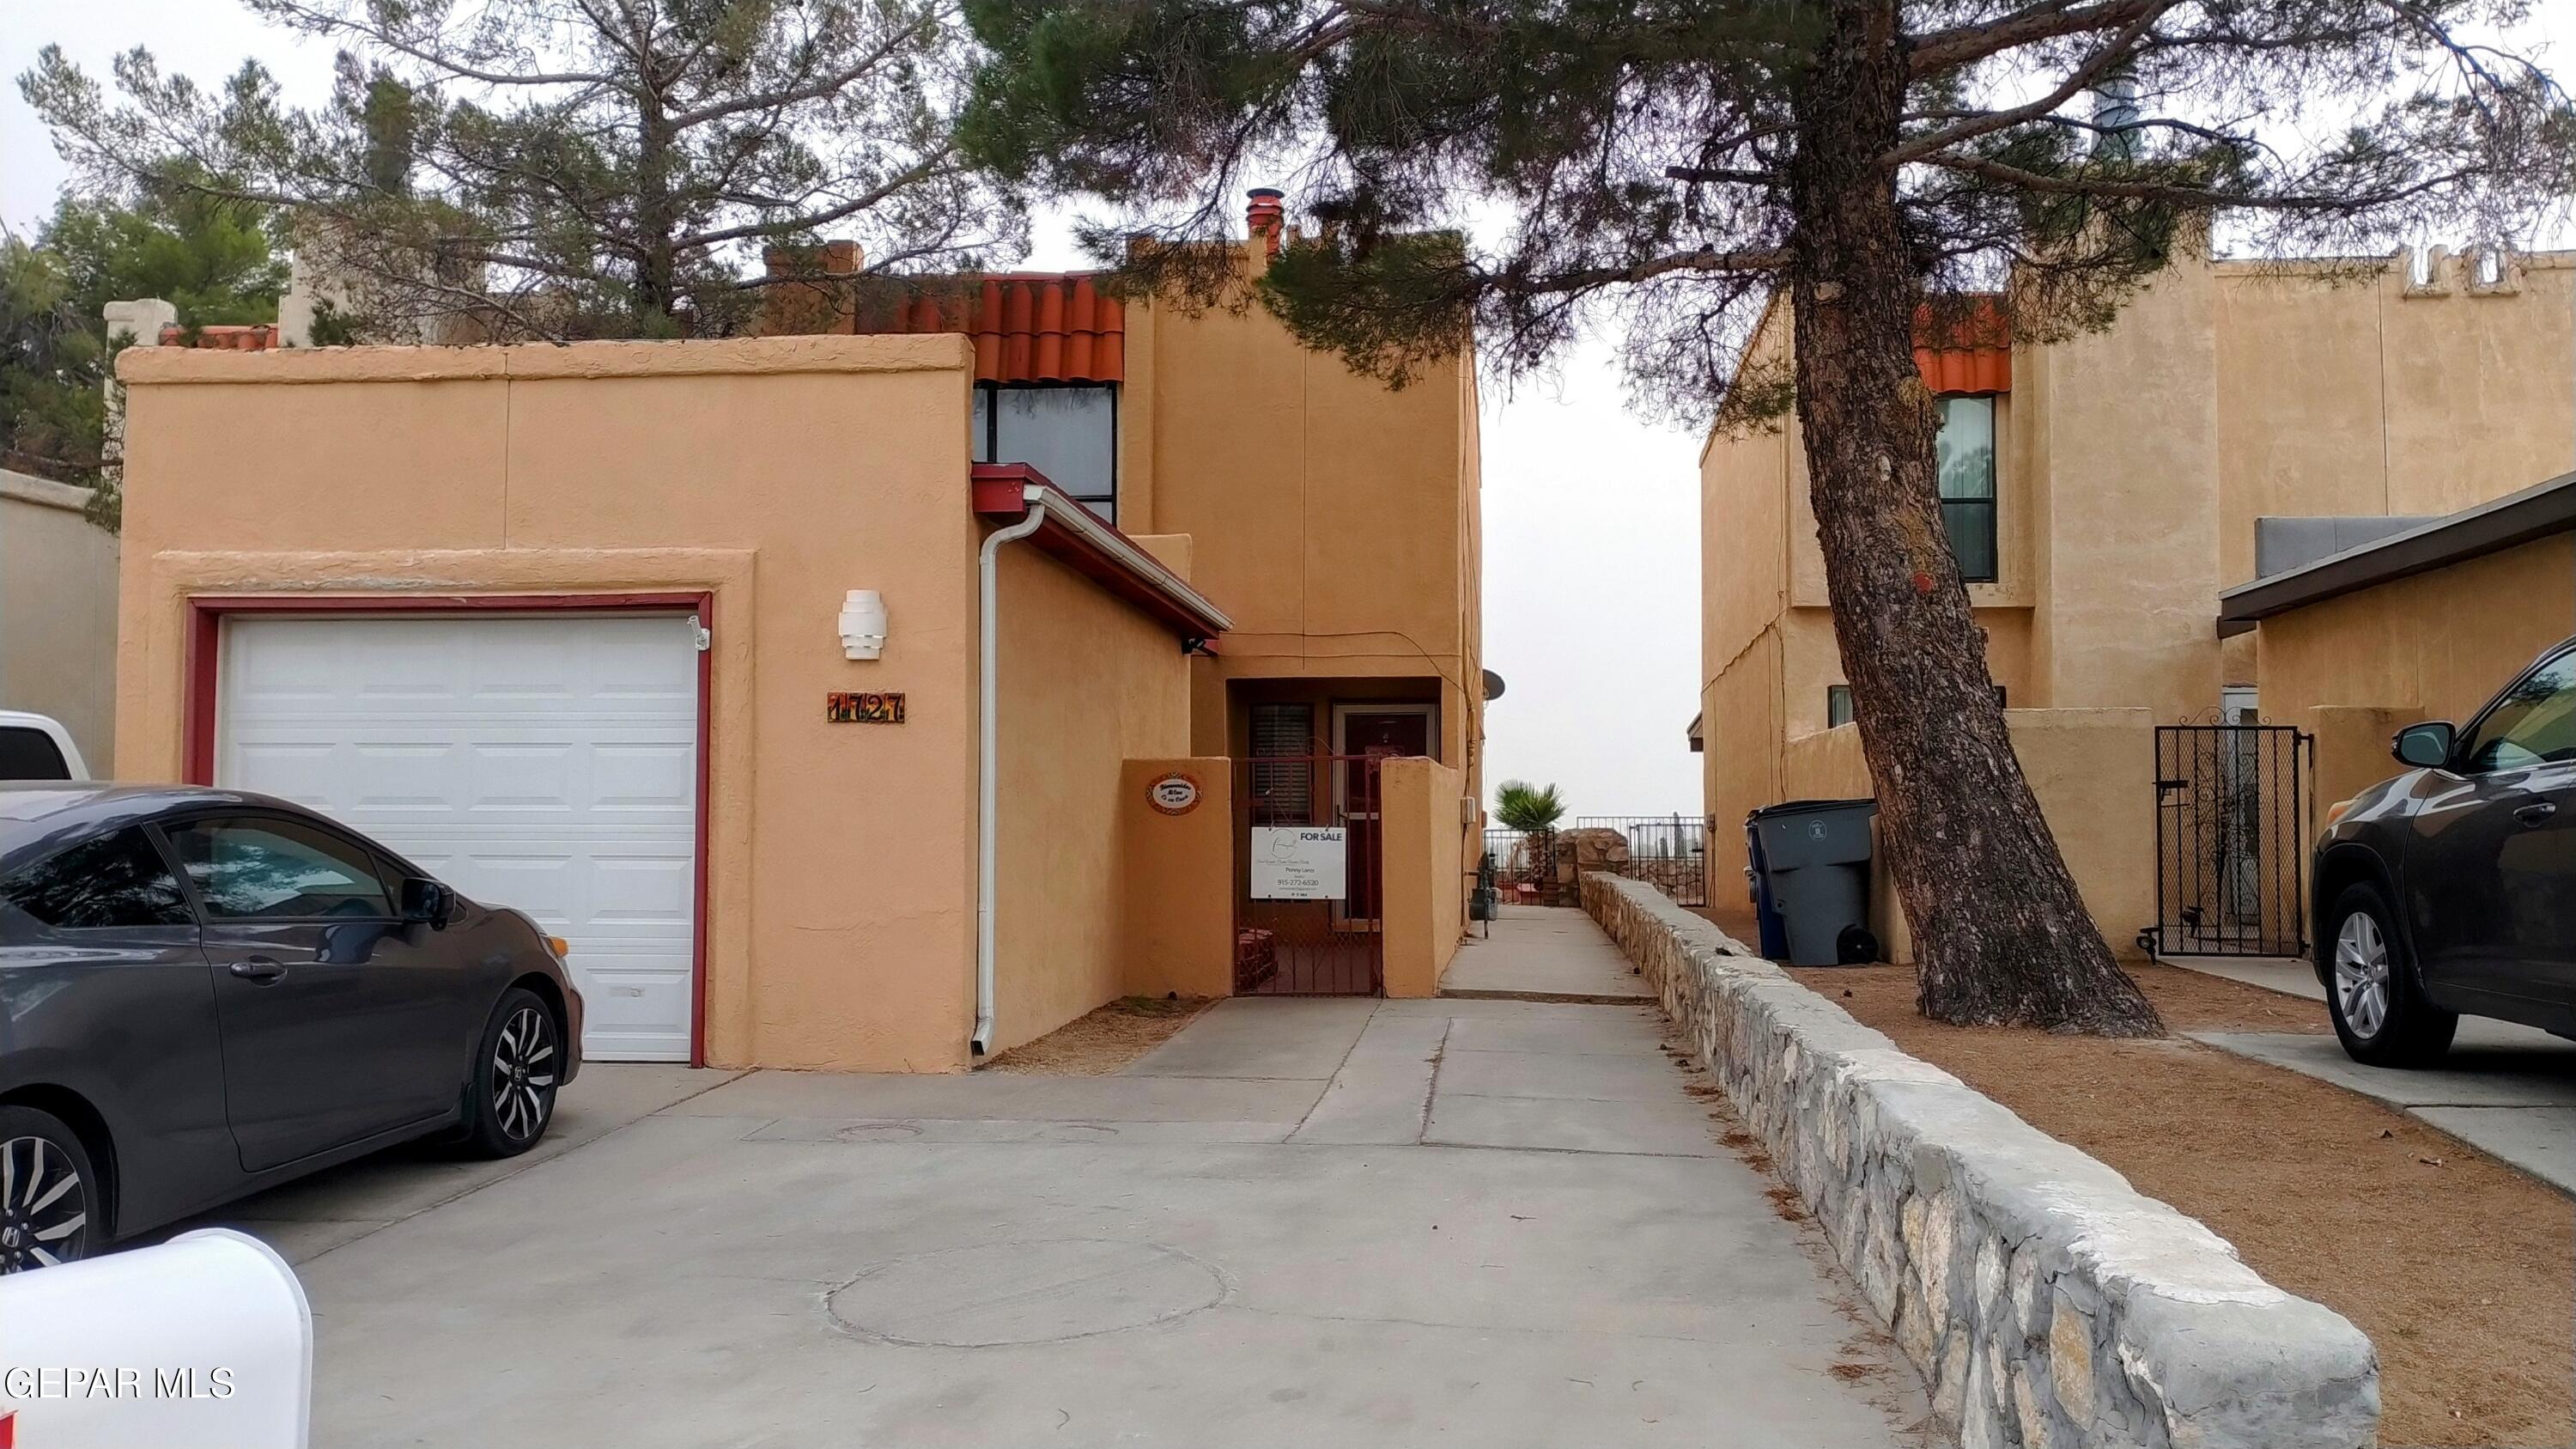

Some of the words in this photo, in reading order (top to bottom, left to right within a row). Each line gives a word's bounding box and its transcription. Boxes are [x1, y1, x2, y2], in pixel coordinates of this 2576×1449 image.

[829, 694, 902, 721] 1727
[1300, 832, 1320, 841] FOR
[1321, 832, 1342, 842] SALE
